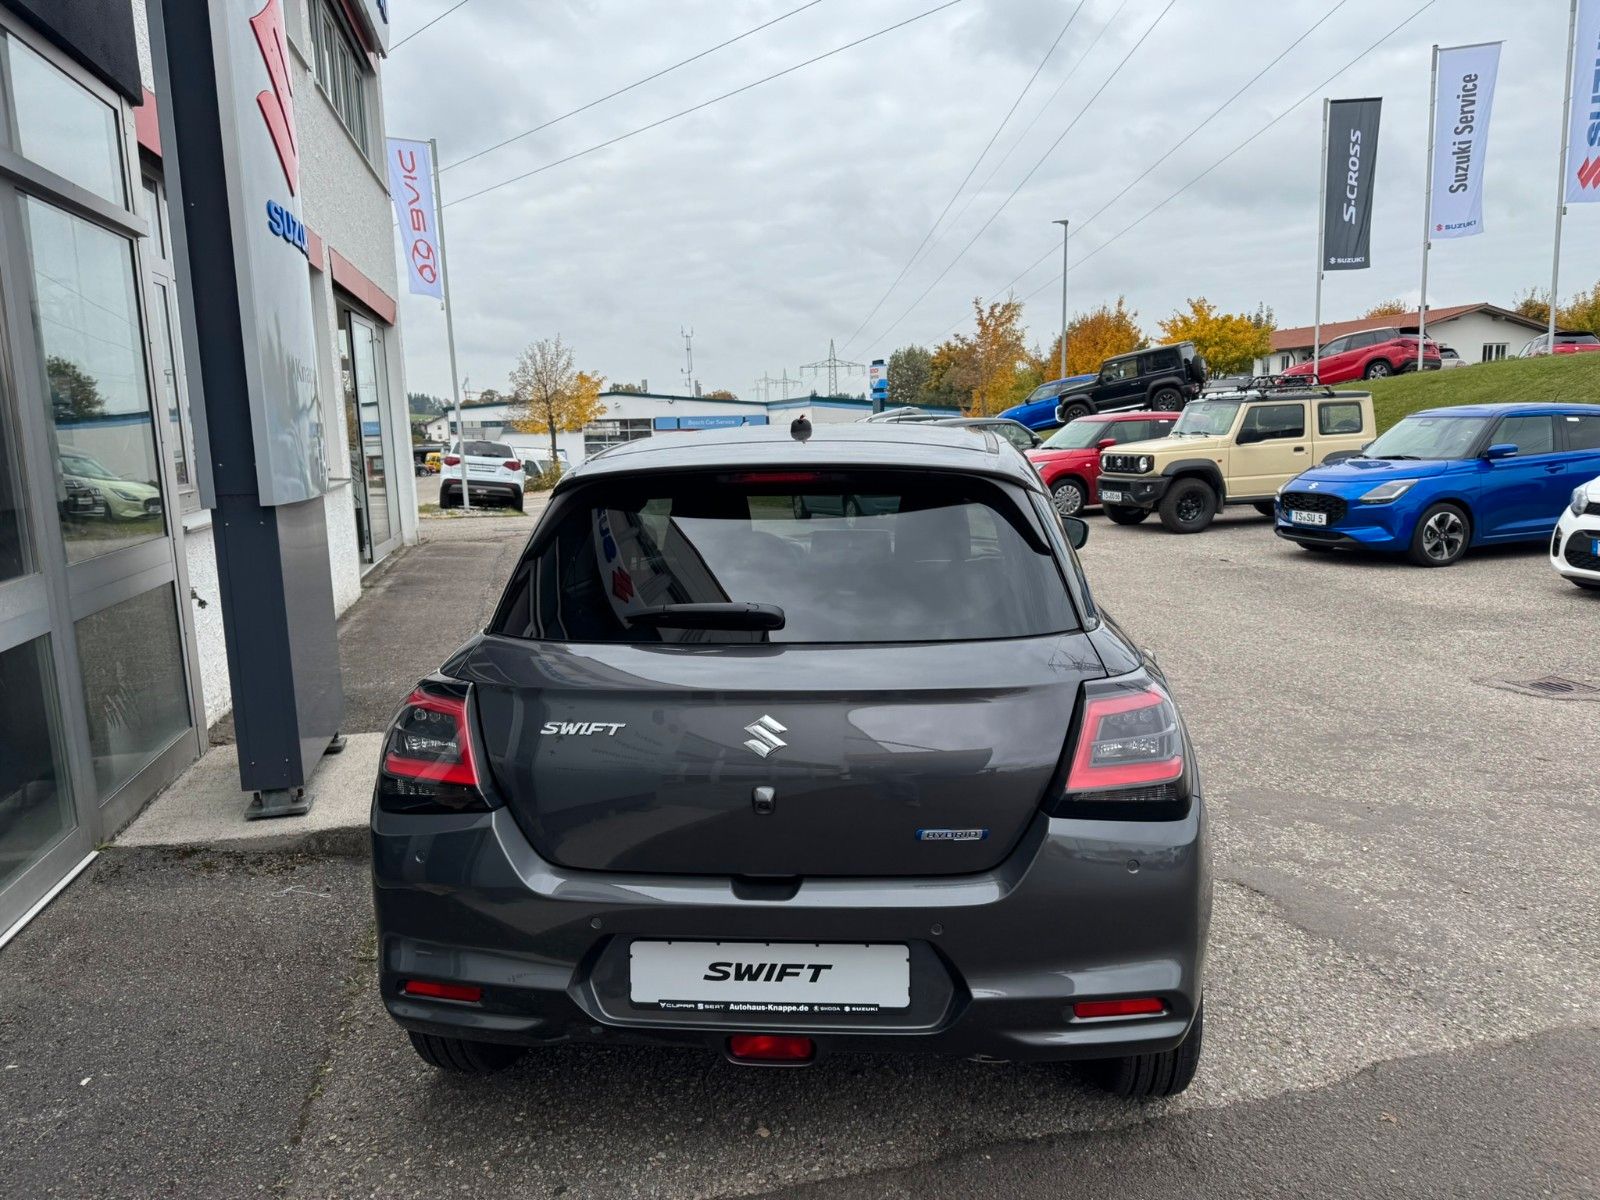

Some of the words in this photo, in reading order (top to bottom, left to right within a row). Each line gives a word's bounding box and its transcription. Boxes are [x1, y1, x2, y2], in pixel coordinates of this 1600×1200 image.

[1453, 73, 1479, 135] Service
[1448, 139, 1473, 194] Suzuki
[1444, 219, 1477, 230] SUZUKI
[1336, 256, 1365, 264] SUZUKI
[1295, 512, 1303, 521] TS
[1306, 513, 1316, 523] SU
[540, 721, 627, 736] SWIFT
[926, 831, 978, 839] HYBRID
[703, 961, 833, 983] SWIFT
[729, 1003, 809, 1013] Autohaus-Knappe.de
